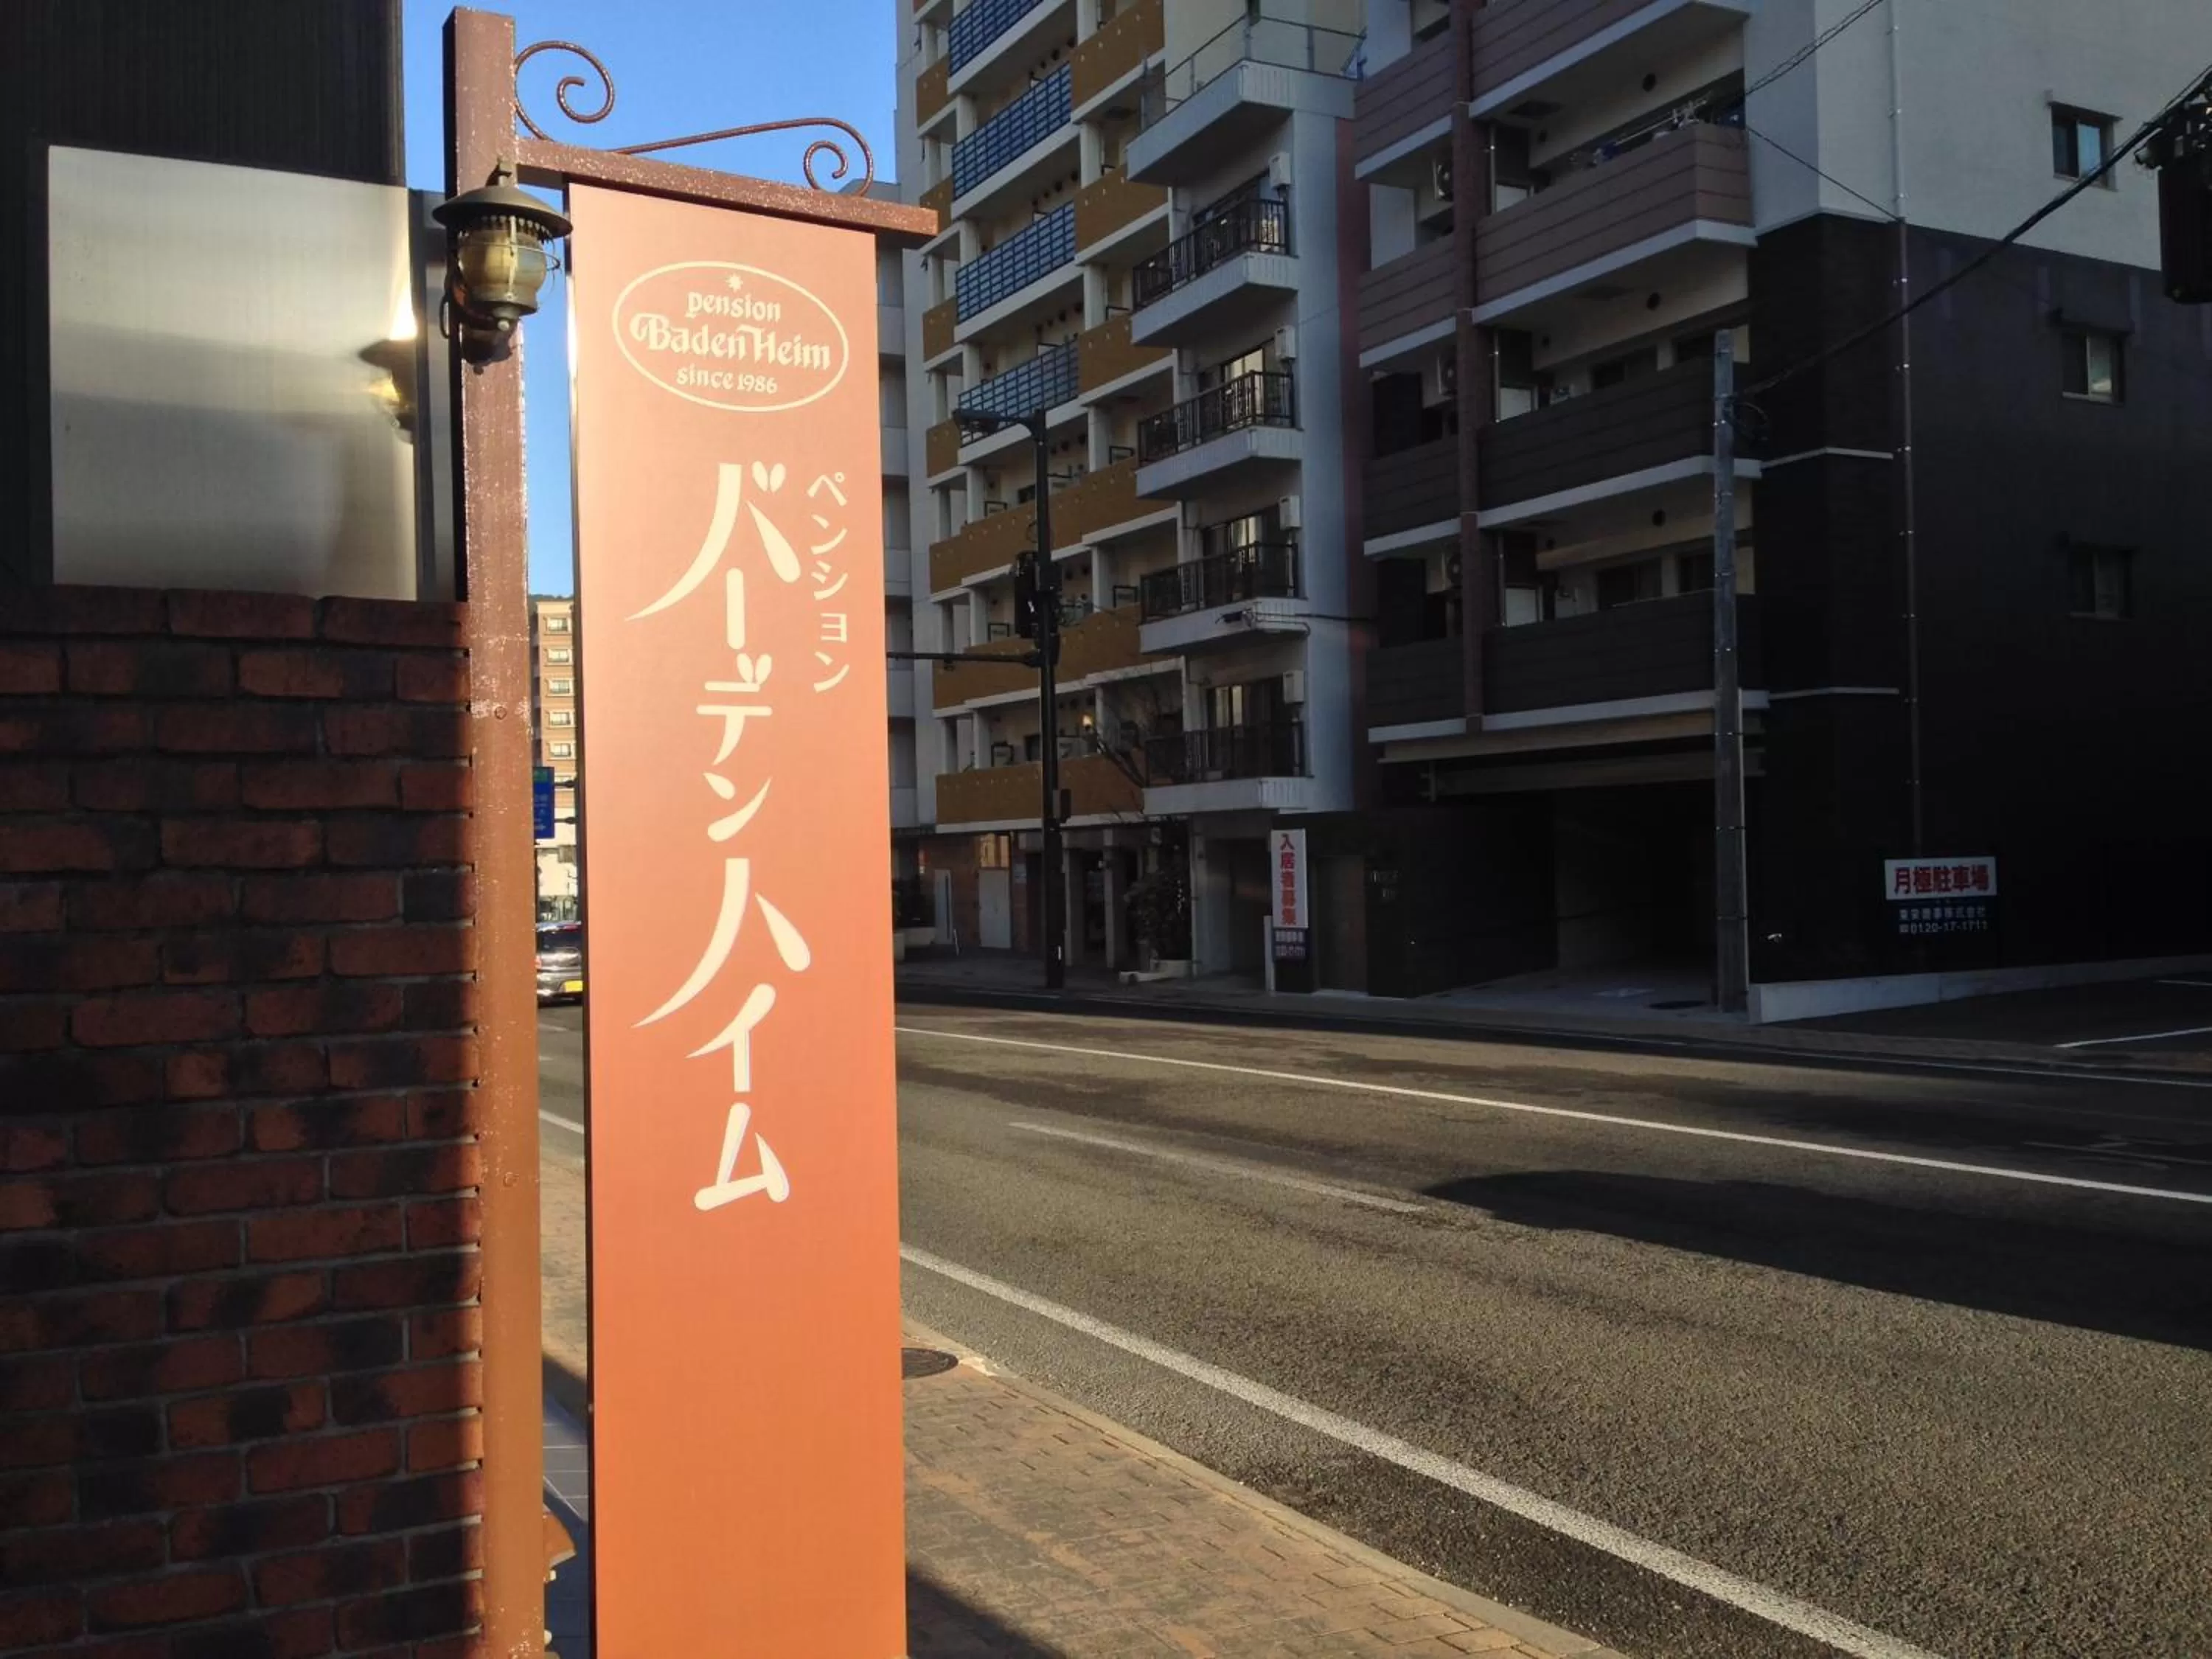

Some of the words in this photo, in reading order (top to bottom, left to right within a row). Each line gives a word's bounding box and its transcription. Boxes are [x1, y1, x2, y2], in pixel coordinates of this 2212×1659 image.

[685, 291, 780, 322] pension
[676, 364, 734, 390] since
[737, 373, 778, 394] 1986
[807, 471, 849, 693] ペンション
[625, 462, 810, 1211] バーデンハイム
[1893, 864, 1989, 895] 月極駐車場
